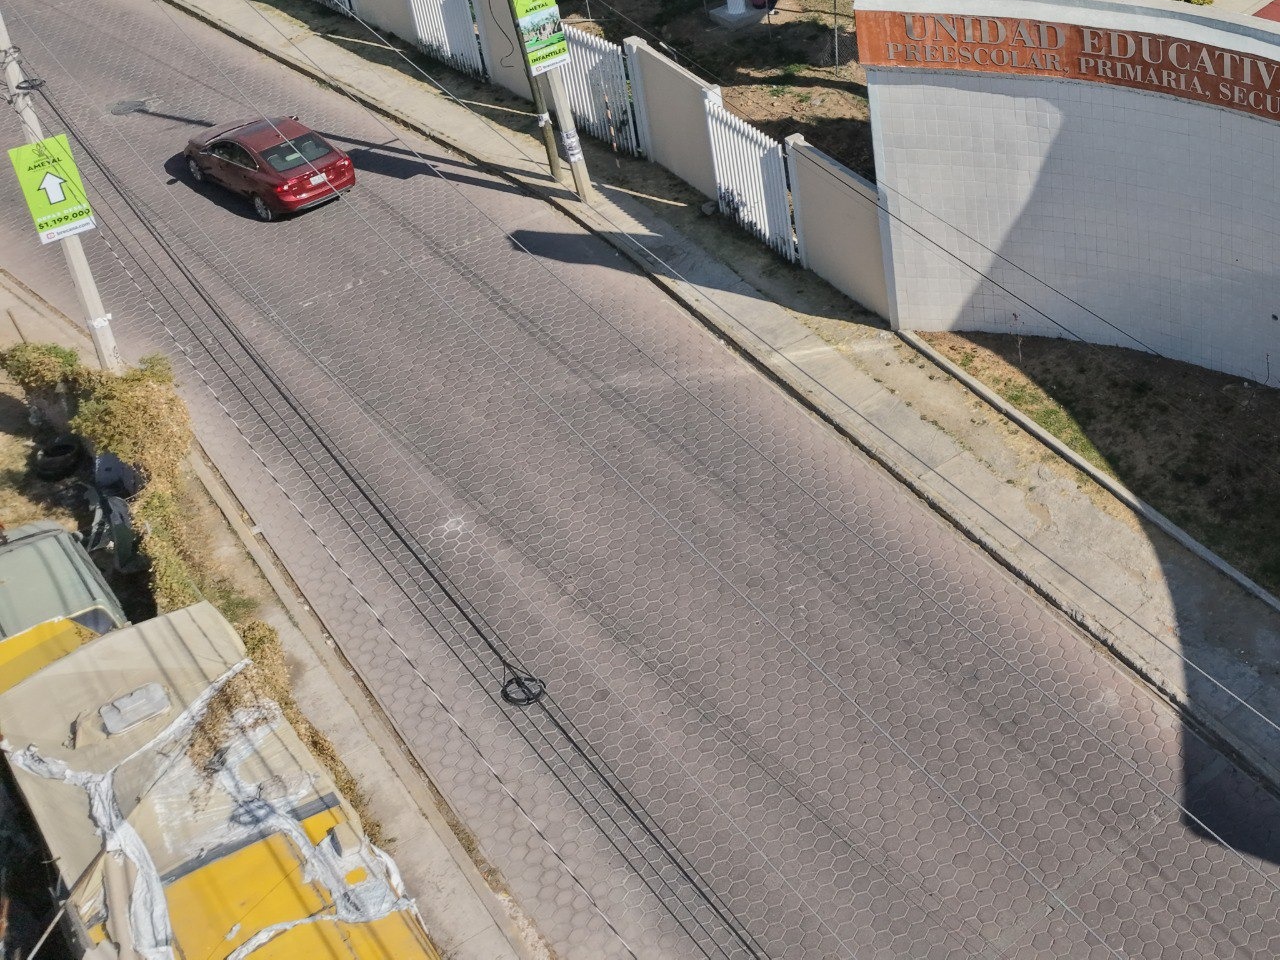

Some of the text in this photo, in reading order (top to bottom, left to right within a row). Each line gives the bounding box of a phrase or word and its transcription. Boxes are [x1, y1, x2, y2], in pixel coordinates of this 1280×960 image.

[900, 13, 1066, 51] UNIDAD
[886, 42, 1070, 75] PREESCOLAR,
[1077, 56, 1211, 100] PRIMARIA,
[38, 208, 91, 229] $1,199,000
